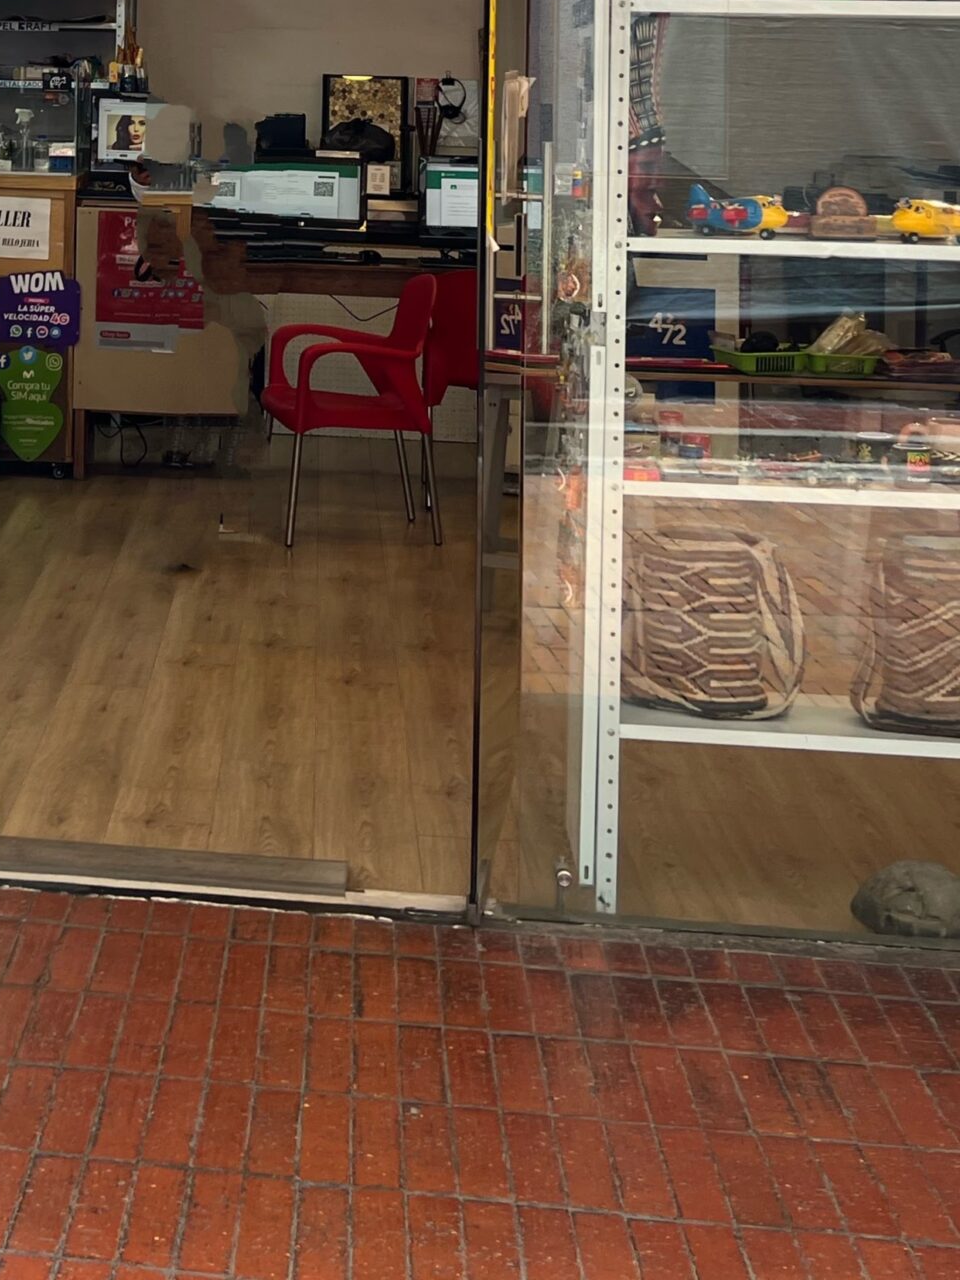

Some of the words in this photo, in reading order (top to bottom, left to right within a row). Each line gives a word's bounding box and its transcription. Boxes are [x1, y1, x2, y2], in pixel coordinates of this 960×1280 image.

[9, 271, 65, 295] WOM
[3, 312, 50, 322] VELOCIDAD
[7, 380, 40, 392] Compra
[41, 381, 51, 391] tu
[11, 391, 28, 401] SIM
